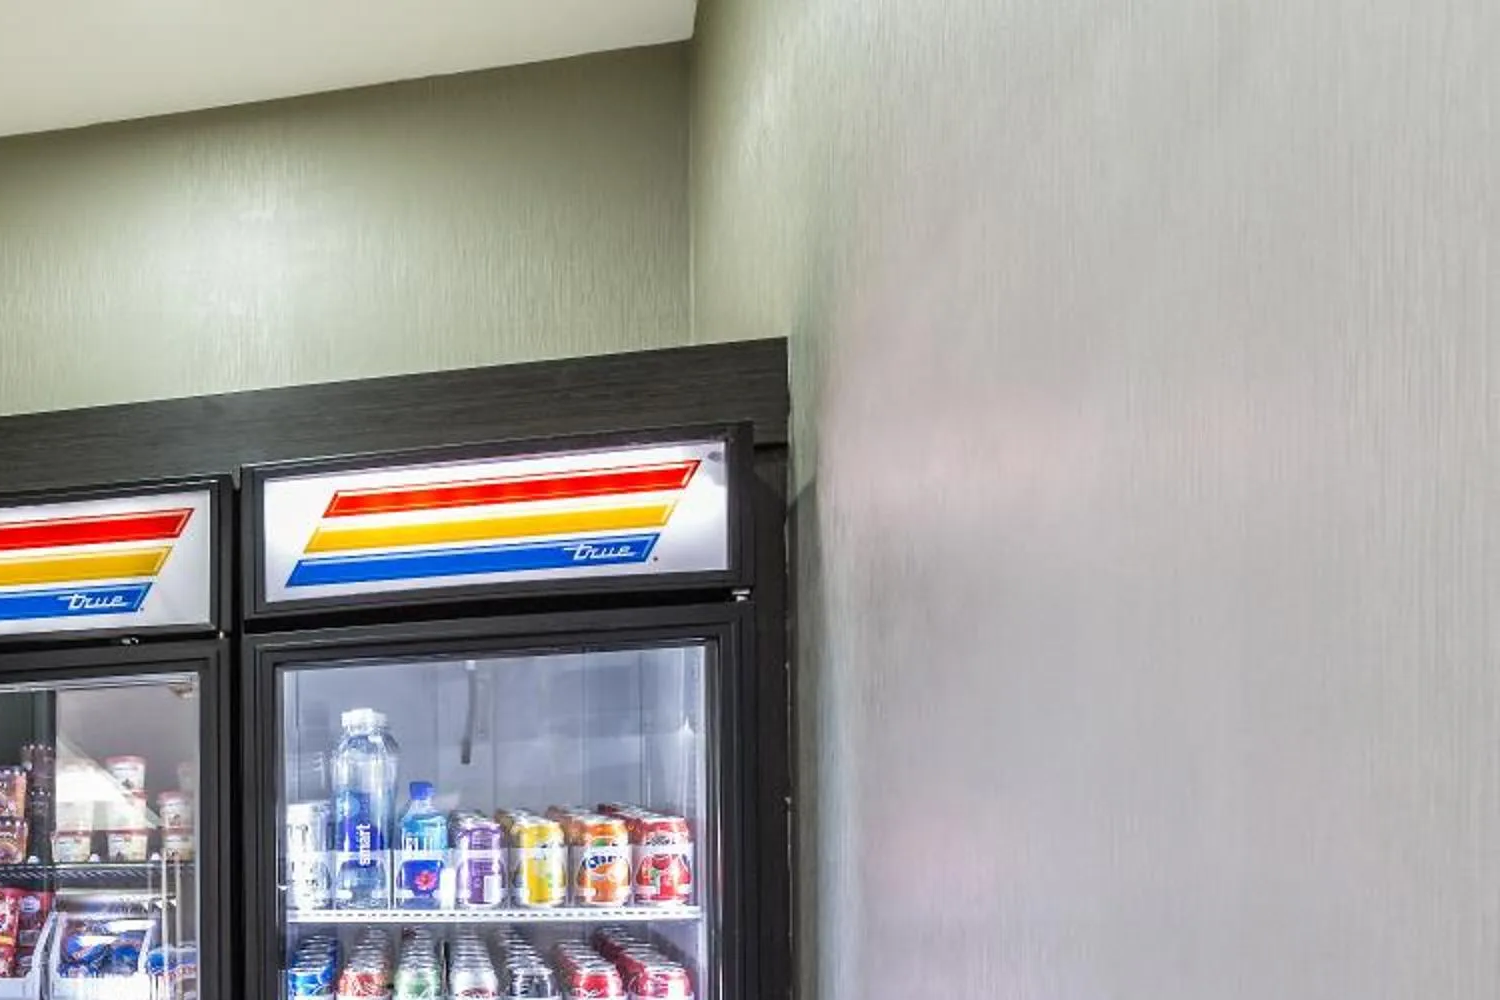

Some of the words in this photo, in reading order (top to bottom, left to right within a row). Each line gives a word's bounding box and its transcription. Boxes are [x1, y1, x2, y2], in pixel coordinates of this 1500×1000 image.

[564, 544, 637, 560] true
[56, 593, 129, 610] true
[356, 823, 371, 866] smart
